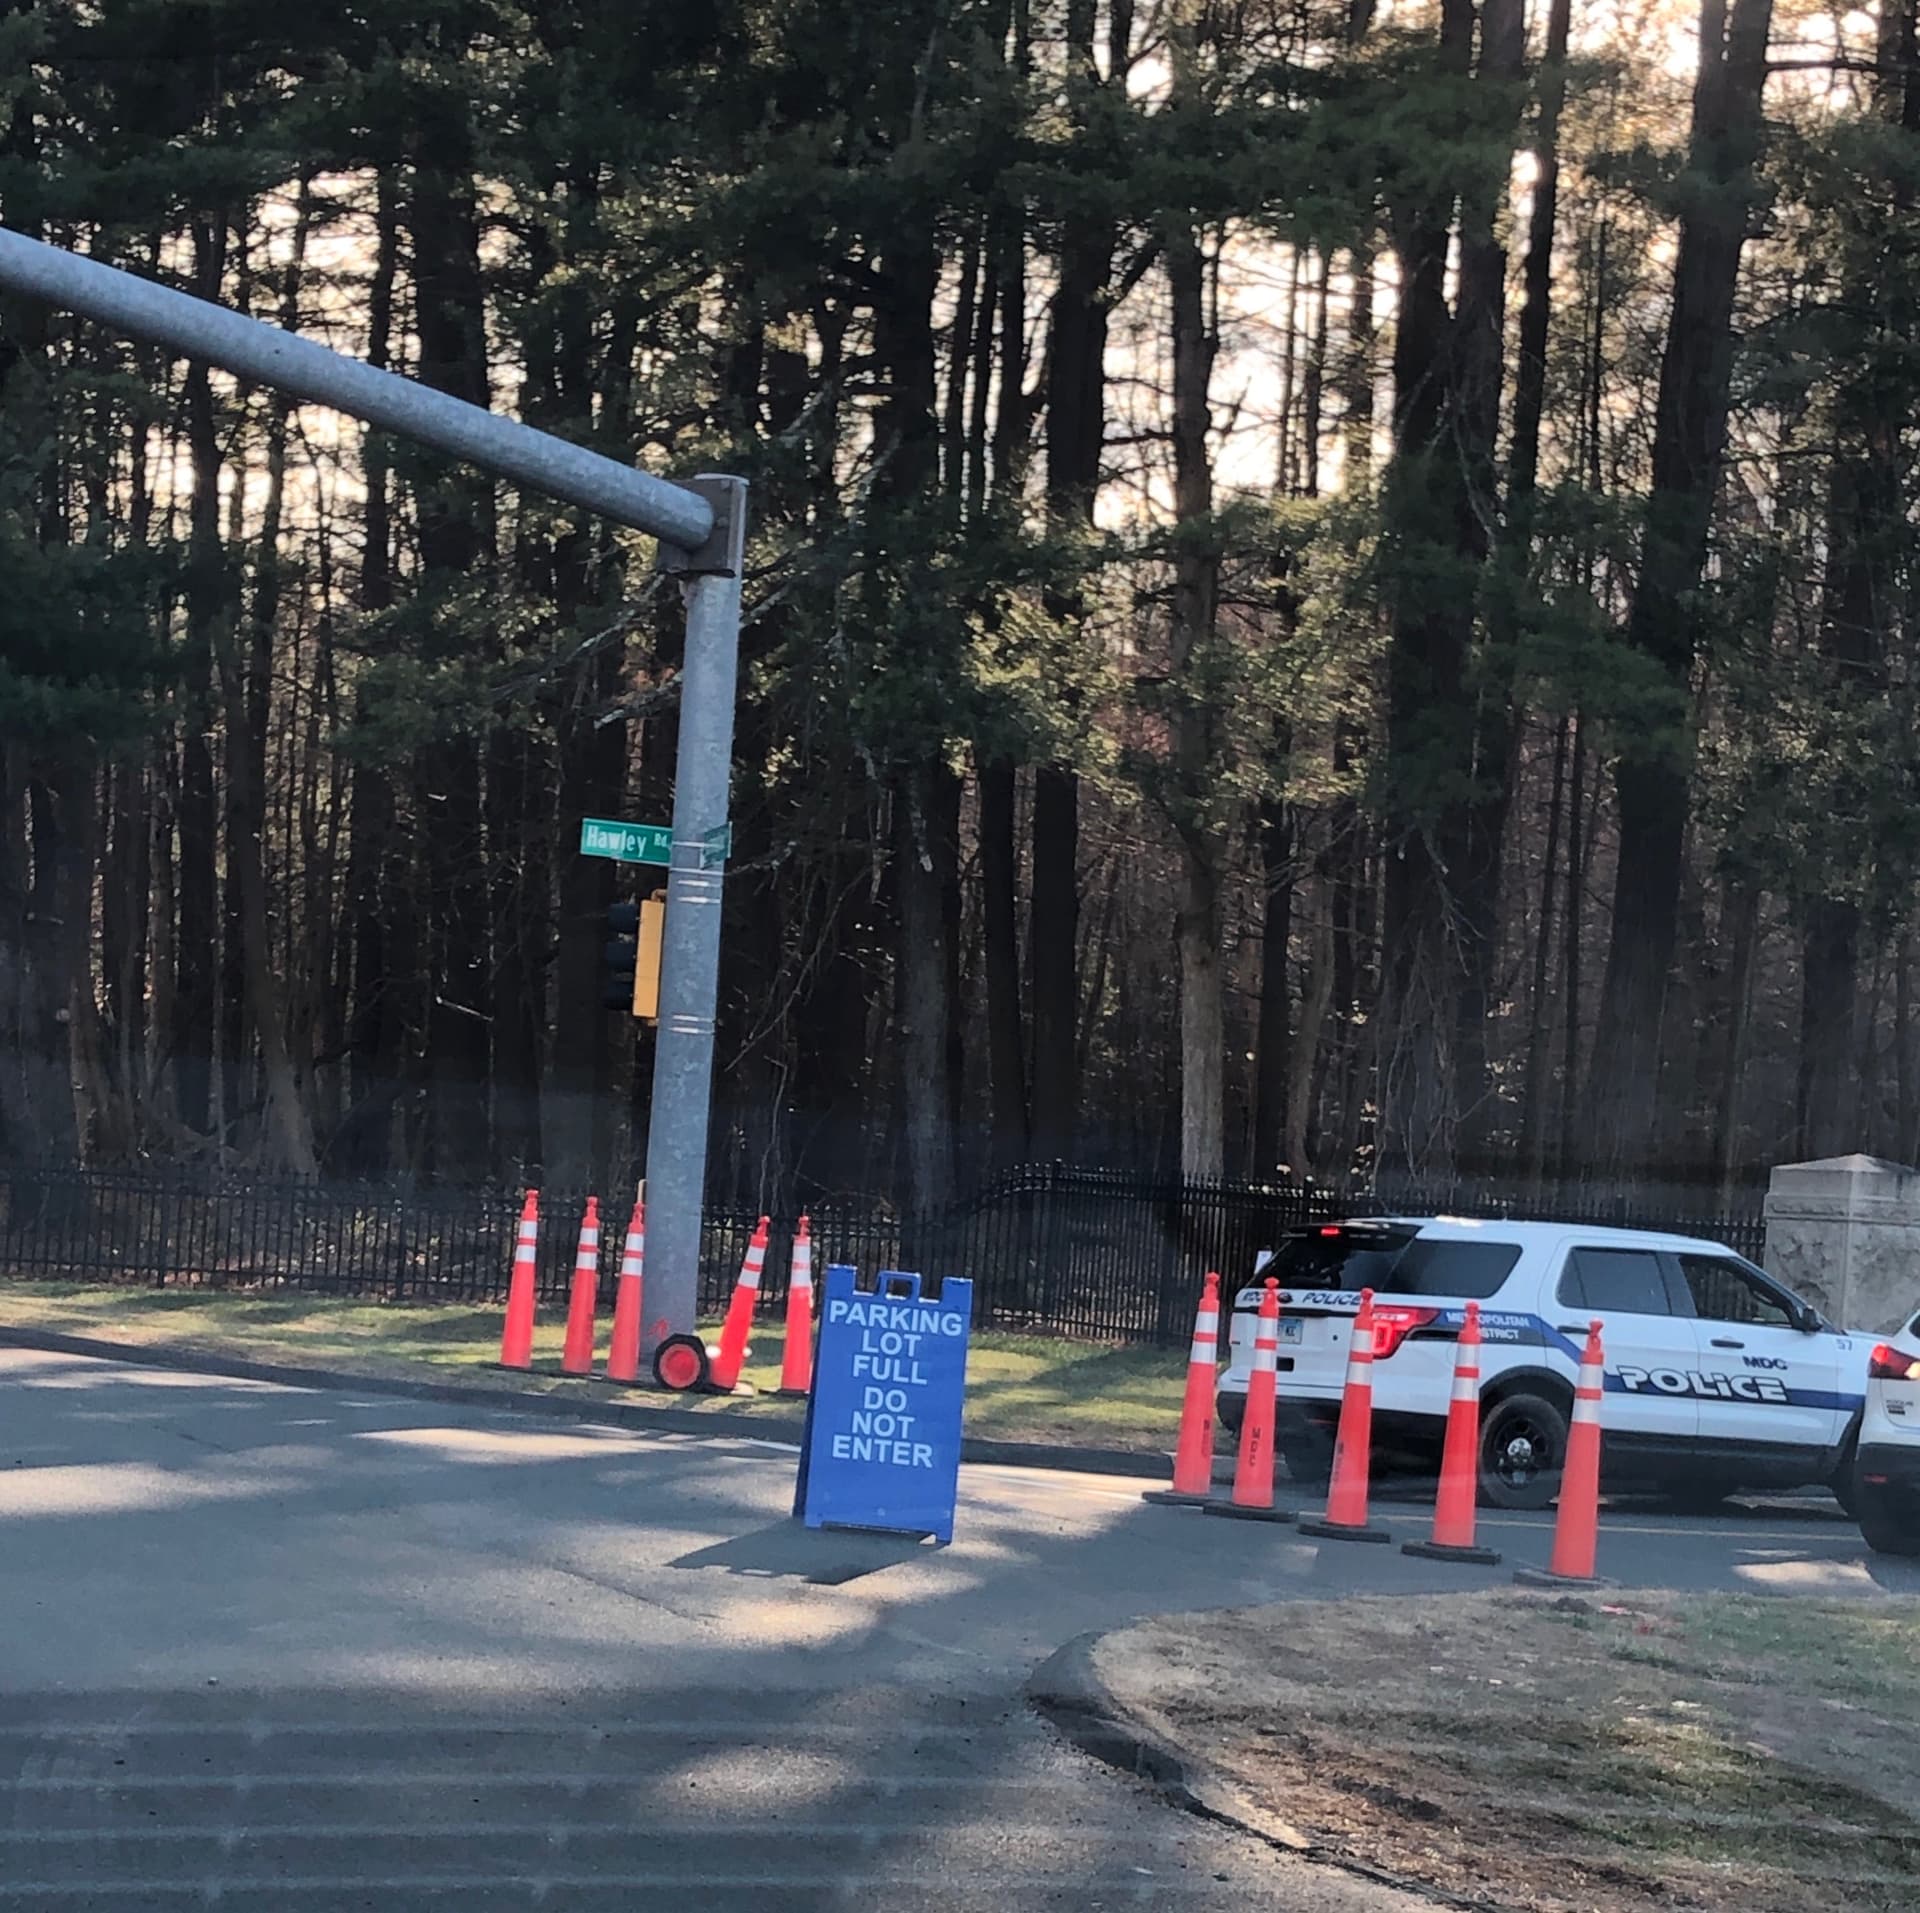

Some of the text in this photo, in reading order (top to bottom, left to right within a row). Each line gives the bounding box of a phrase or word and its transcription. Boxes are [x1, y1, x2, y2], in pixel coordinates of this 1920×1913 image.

[588, 826, 646, 857] Hawley
[1303, 1292, 1361, 1306] POLICE
[830, 1300, 962, 1336] PARKING
[1446, 1312, 1530, 1327] MEOPOLITAN
[863, 1331, 921, 1357] LOT
[853, 1356, 927, 1384] FULL
[1743, 1356, 1788, 1370] MDC
[865, 1387, 907, 1412] DO
[853, 1411, 914, 1439] NOT
[832, 1435, 932, 1468] ENTER
